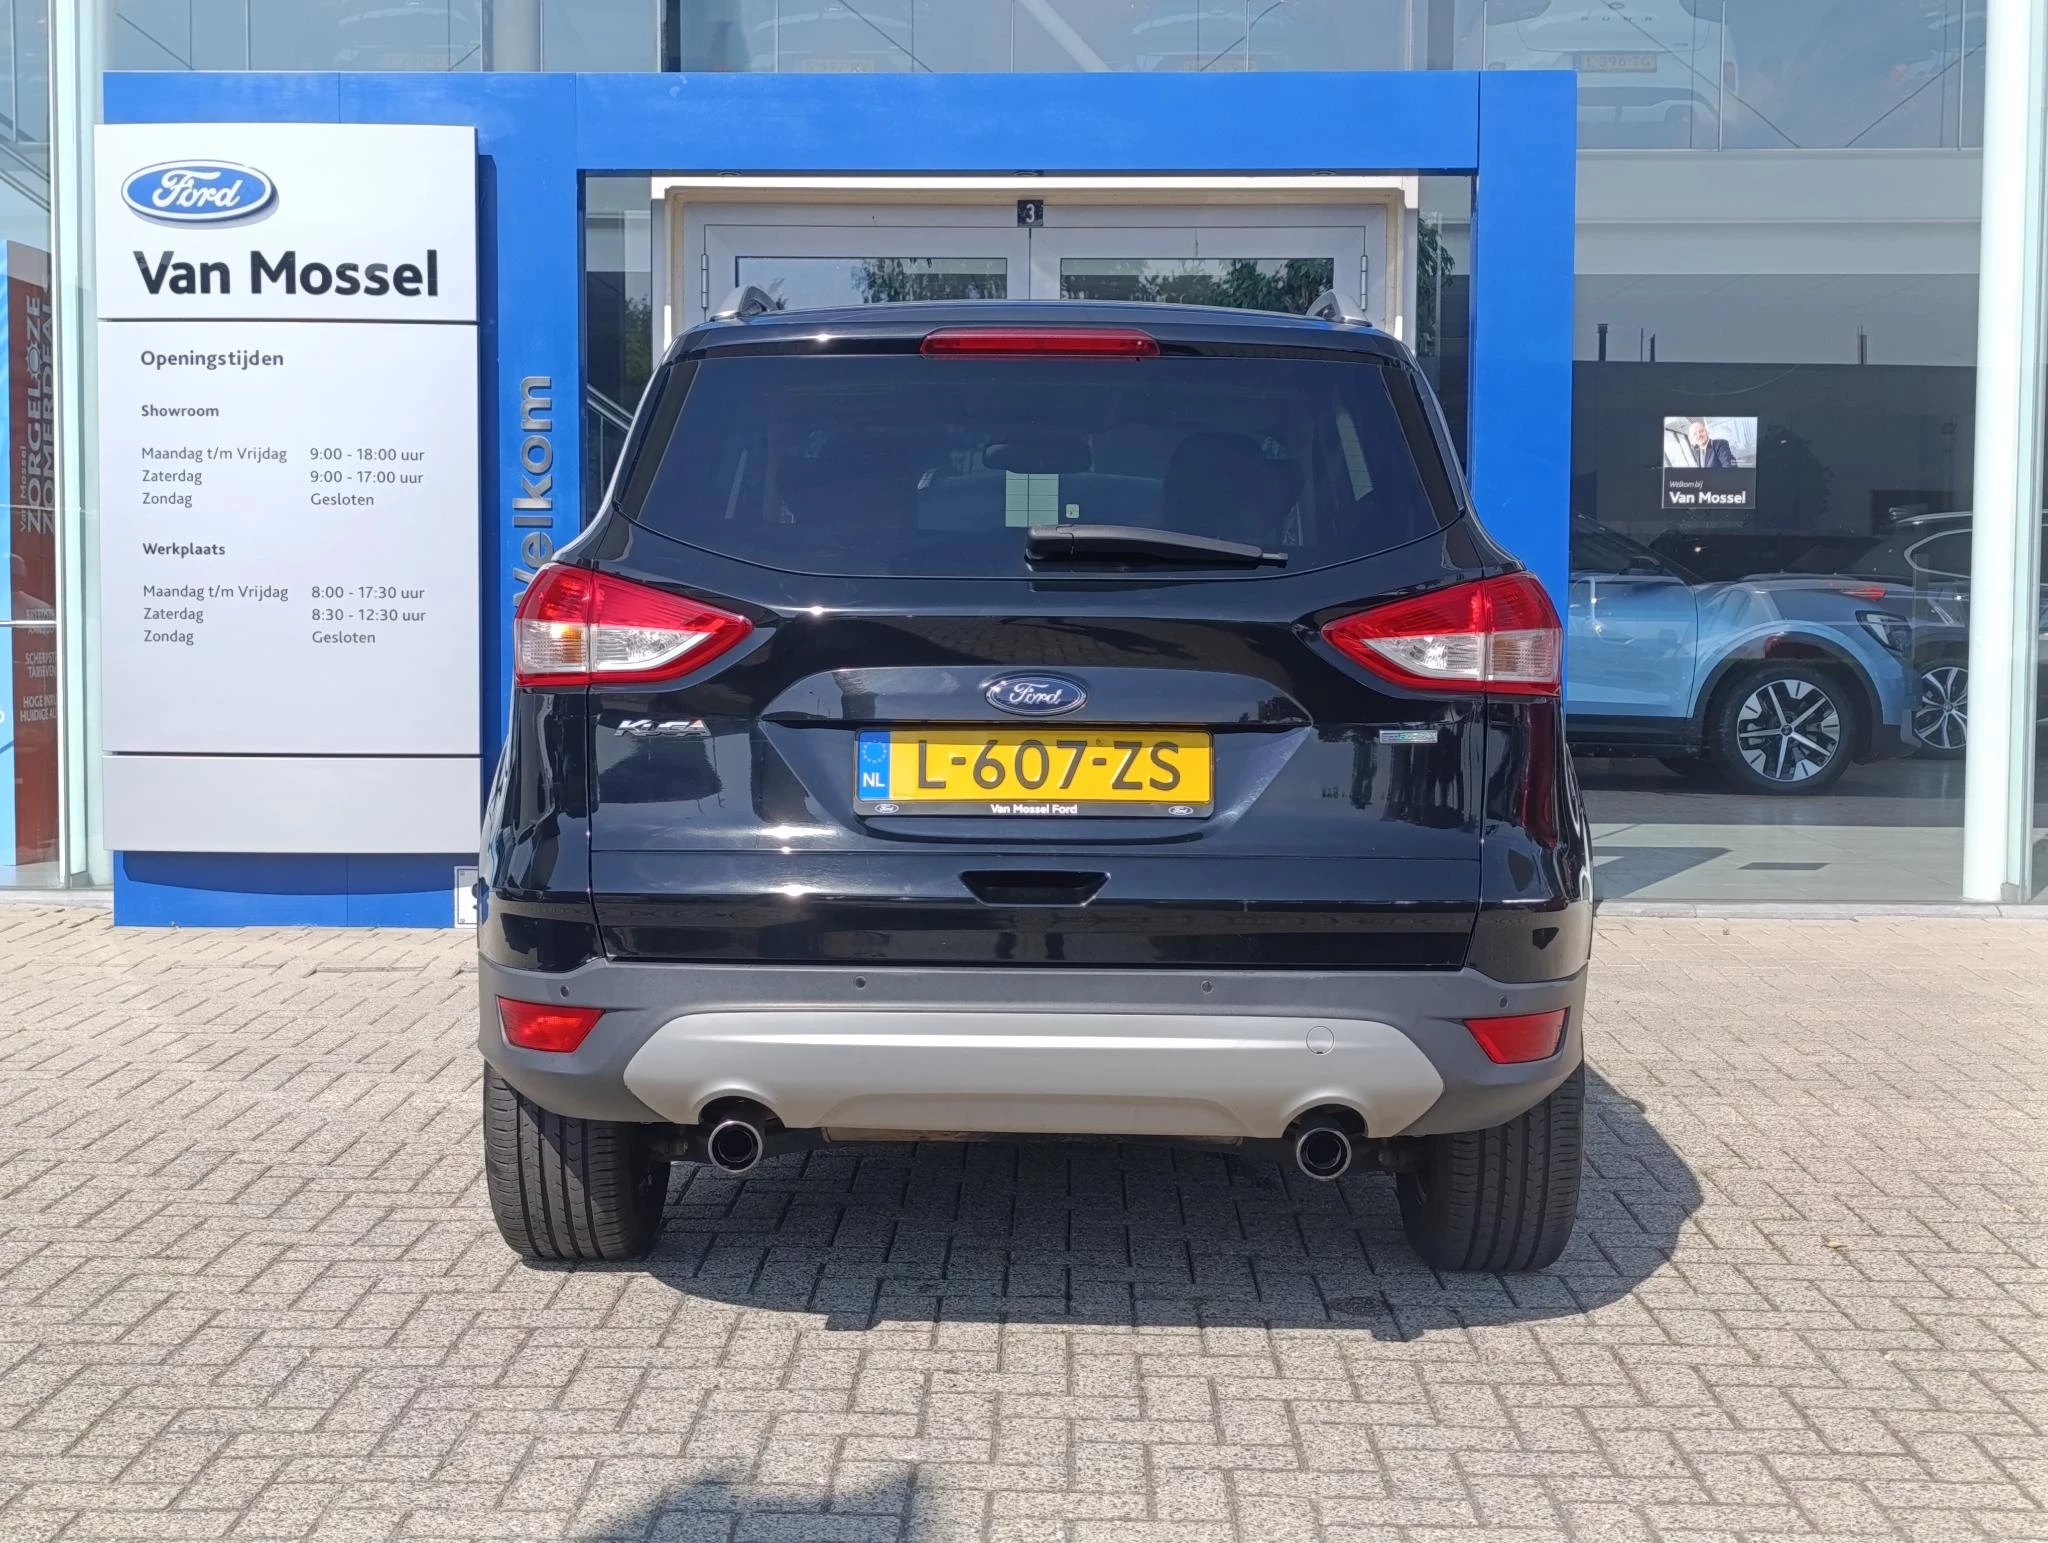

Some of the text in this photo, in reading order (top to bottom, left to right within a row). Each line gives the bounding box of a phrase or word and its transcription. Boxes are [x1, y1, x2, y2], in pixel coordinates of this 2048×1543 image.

[152, 169, 244, 208] Ford
[1026, 204, 1035, 223] 3
[133, 249, 439, 297] Van Mossel
[141, 350, 284, 371] Openingstijden
[142, 403, 220, 417] Showroom
[142, 447, 204, 463] Maandag
[207, 447, 233, 460] t/m
[237, 447, 288, 463] Vrijdag
[310, 448, 343, 461] 9:00
[357, 448, 397, 461] 18:00
[401, 451, 425, 461] uur
[142, 470, 203, 486] Zaterdag
[310, 471, 343, 483] 9:00
[357, 471, 396, 483] 17:00
[400, 475, 424, 484] uur
[142, 492, 375, 508] Zondag Gesloten
[1669, 491, 1746, 504] Van Mossel
[143, 541, 226, 560] Werkplaats
[143, 585, 205, 601] Maandag
[208, 585, 234, 598] t/m
[238, 586, 289, 602] Vrijdag
[311, 586, 344, 599] 8:00
[358, 586, 397, 599] 17:30
[401, 589, 425, 599] uur
[143, 607, 204, 623] Zaterdag
[311, 608, 344, 621] 8:30
[358, 608, 398, 621] 12:30
[402, 612, 427, 622] uur
[143, 630, 376, 646] Zondag Gesloten
[23, 695, 43, 708] HOGE
[1008, 682, 1064, 706] Ford
[917, 739, 1181, 790] L-607-ZS
[863, 772, 886, 788] NL
[990, 803, 1078, 814] Van Mossel Ford
